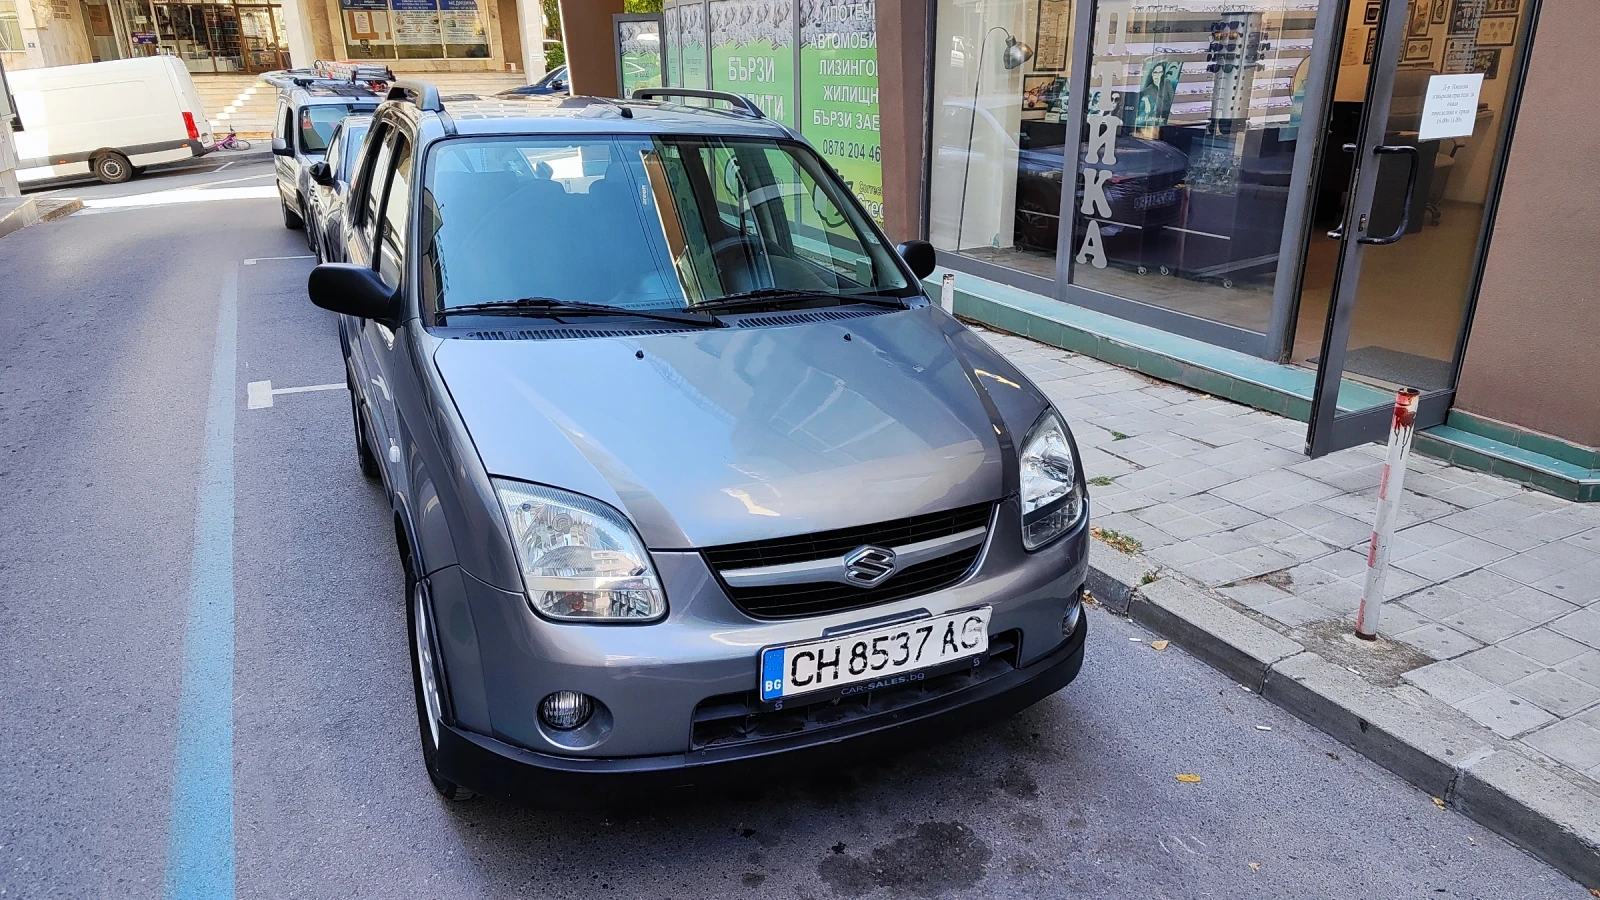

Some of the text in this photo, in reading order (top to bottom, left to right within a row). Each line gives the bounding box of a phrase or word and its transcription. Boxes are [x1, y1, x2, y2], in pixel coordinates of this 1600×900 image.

[822, 2, 876, 22] ИПОТЕЧ
[728, 55, 775, 83] БЪРЗИ
[819, 59, 878, 77] ЛИЗИНГО
[823, 85, 879, 107] ЖИЛИЩН
[813, 109, 880, 132] БЪРЗИ ЗАЕ
[823, 139, 881, 163] 0878 204 46
[791, 646, 841, 687] CH
[848, 625, 934, 676] 8537
[765, 679, 782, 692] BG
[841, 672, 925, 696] CAR-SALES.bg
